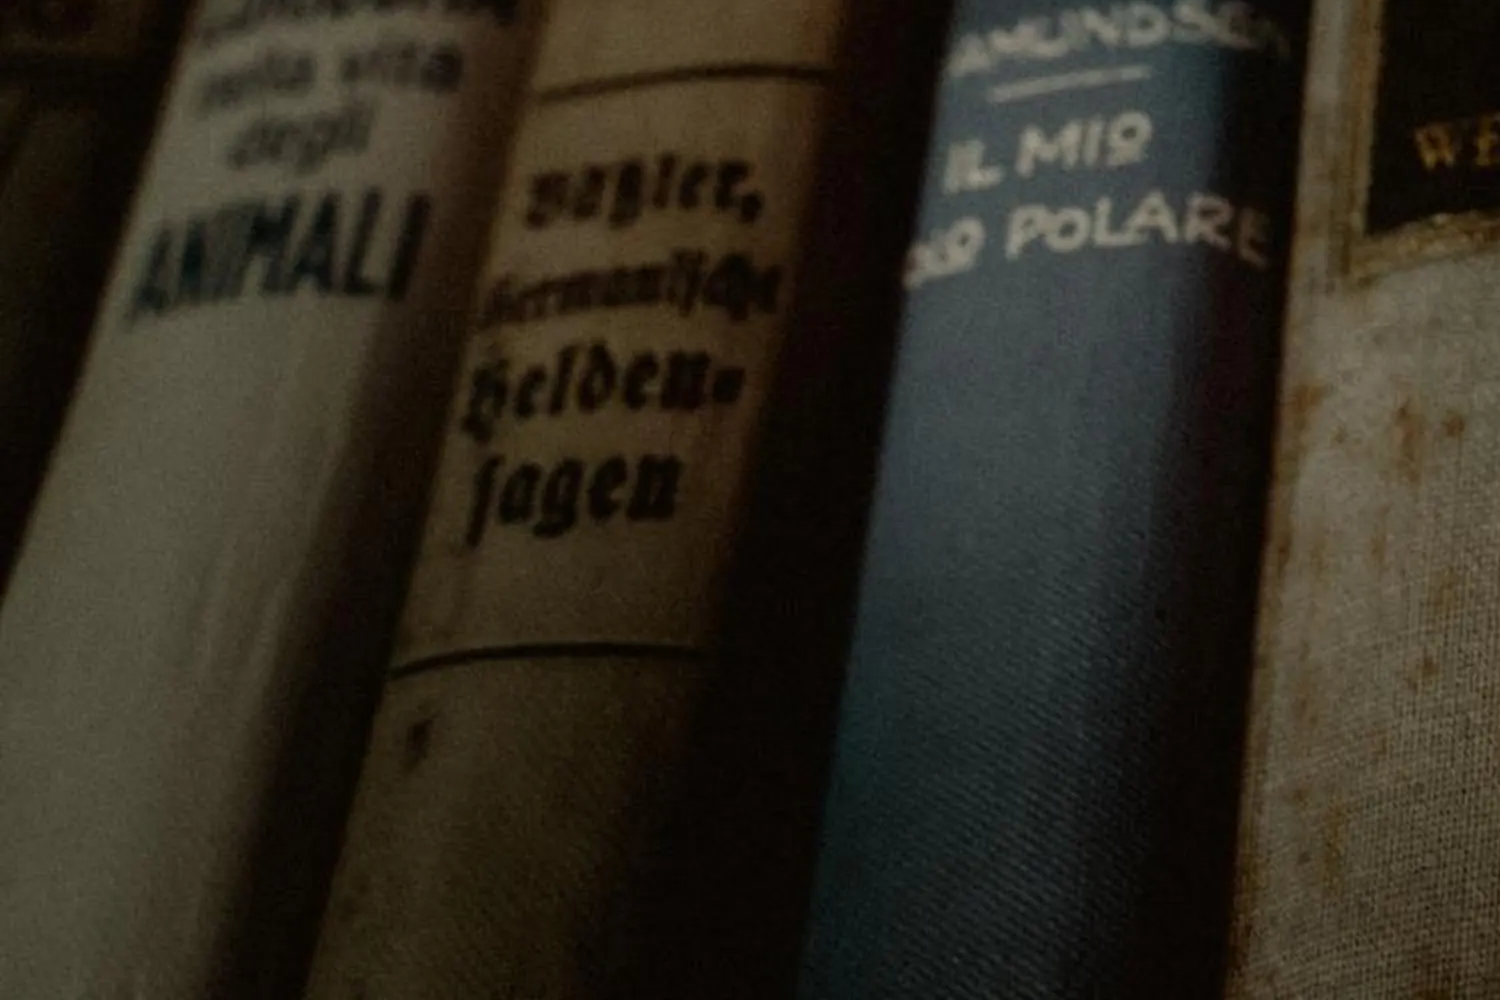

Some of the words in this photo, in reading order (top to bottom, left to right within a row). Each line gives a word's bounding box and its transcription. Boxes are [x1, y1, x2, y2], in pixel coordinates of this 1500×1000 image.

[1014, 110, 1153, 178] MIO
[126, 188, 430, 332] ANIMALI
[1005, 189, 1272, 271] POLARE
